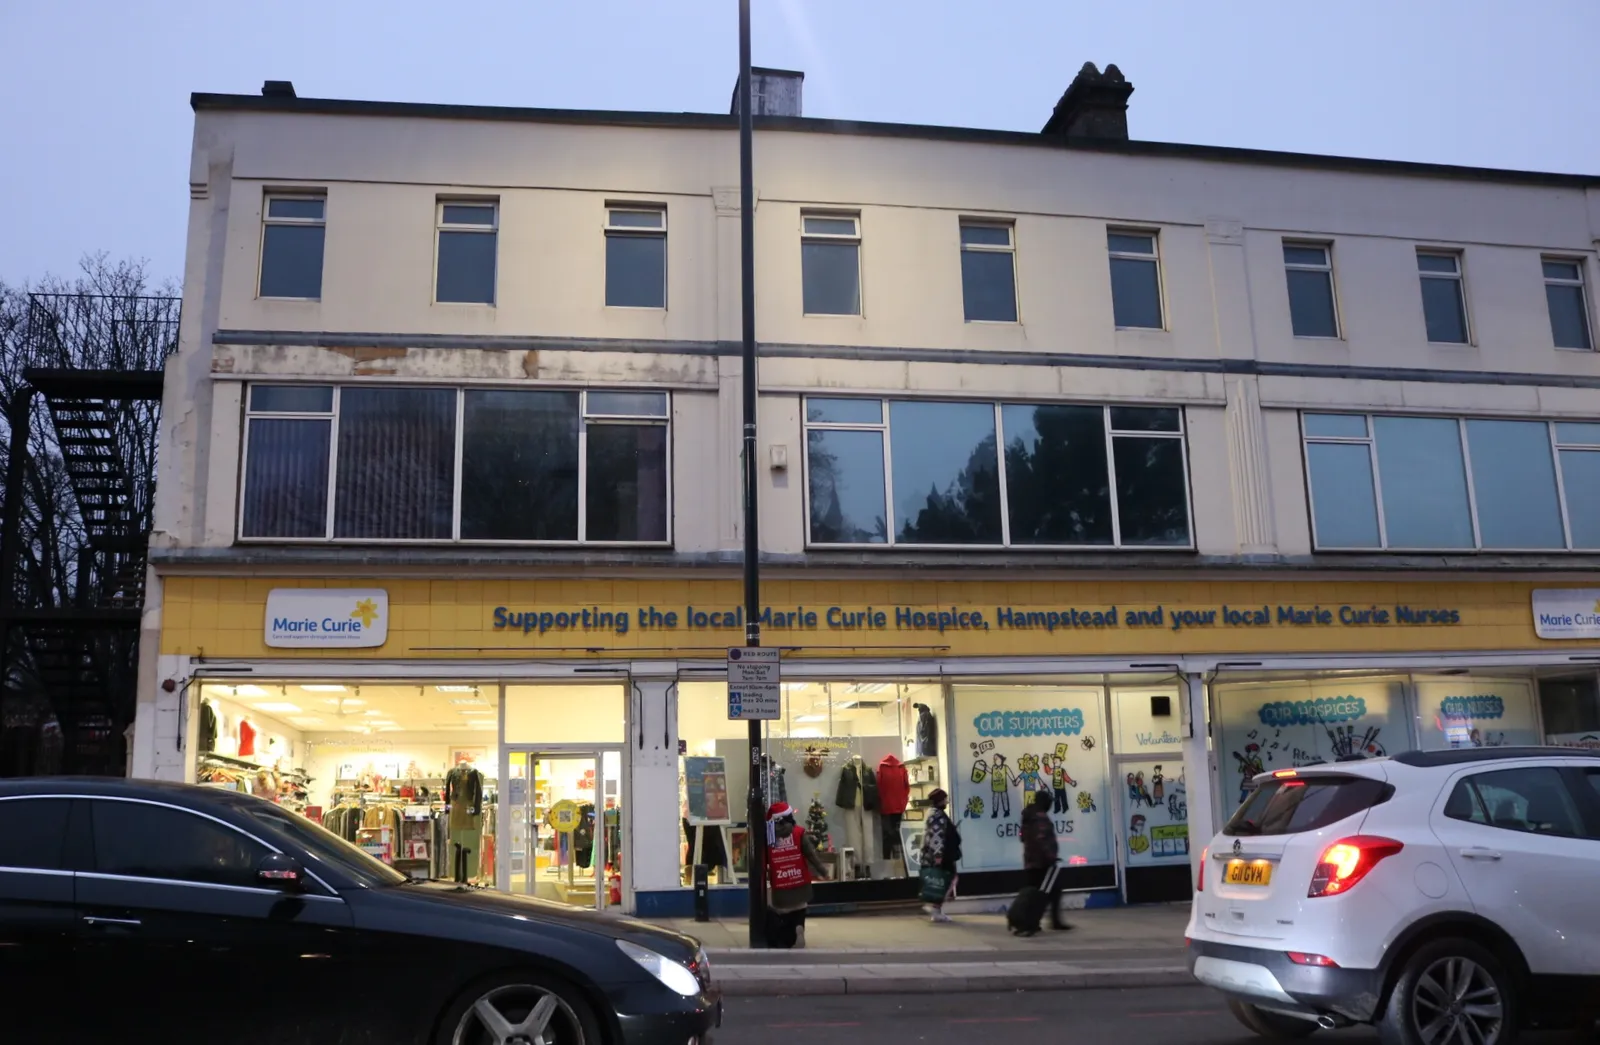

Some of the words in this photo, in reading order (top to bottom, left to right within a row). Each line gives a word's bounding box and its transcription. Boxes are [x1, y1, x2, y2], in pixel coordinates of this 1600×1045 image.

[273, 617, 317, 632] Marie
[321, 618, 361, 632] Curie
[493, 605, 630, 634] Supporting
[638, 604, 678, 630] the
[686, 605, 743, 630] local
[758, 606, 818, 629] Marie
[826, 606, 887, 629] Curie
[894, 606, 989, 632] Hospice,
[997, 605, 1118, 633] Hampstead
[1125, 605, 1164, 628] and
[1170, 608, 1216, 631] your
[1222, 605, 1271, 626] local
[1277, 605, 1333, 626] Marie
[1338, 605, 1390, 626] Curie
[1397, 605, 1461, 626] Nurses
[1540, 613, 1572, 625] Marie
[1264, 707, 1293, 721] OUR
[1297, 701, 1360, 719] HOSPICES
[1445, 703, 1465, 715] OUR
[1467, 701, 1501, 714] NURSES
[980, 716, 1004, 731] OUR
[1009, 715, 1080, 731] SUPPORTERS
[776, 867, 802, 880] Zettle
